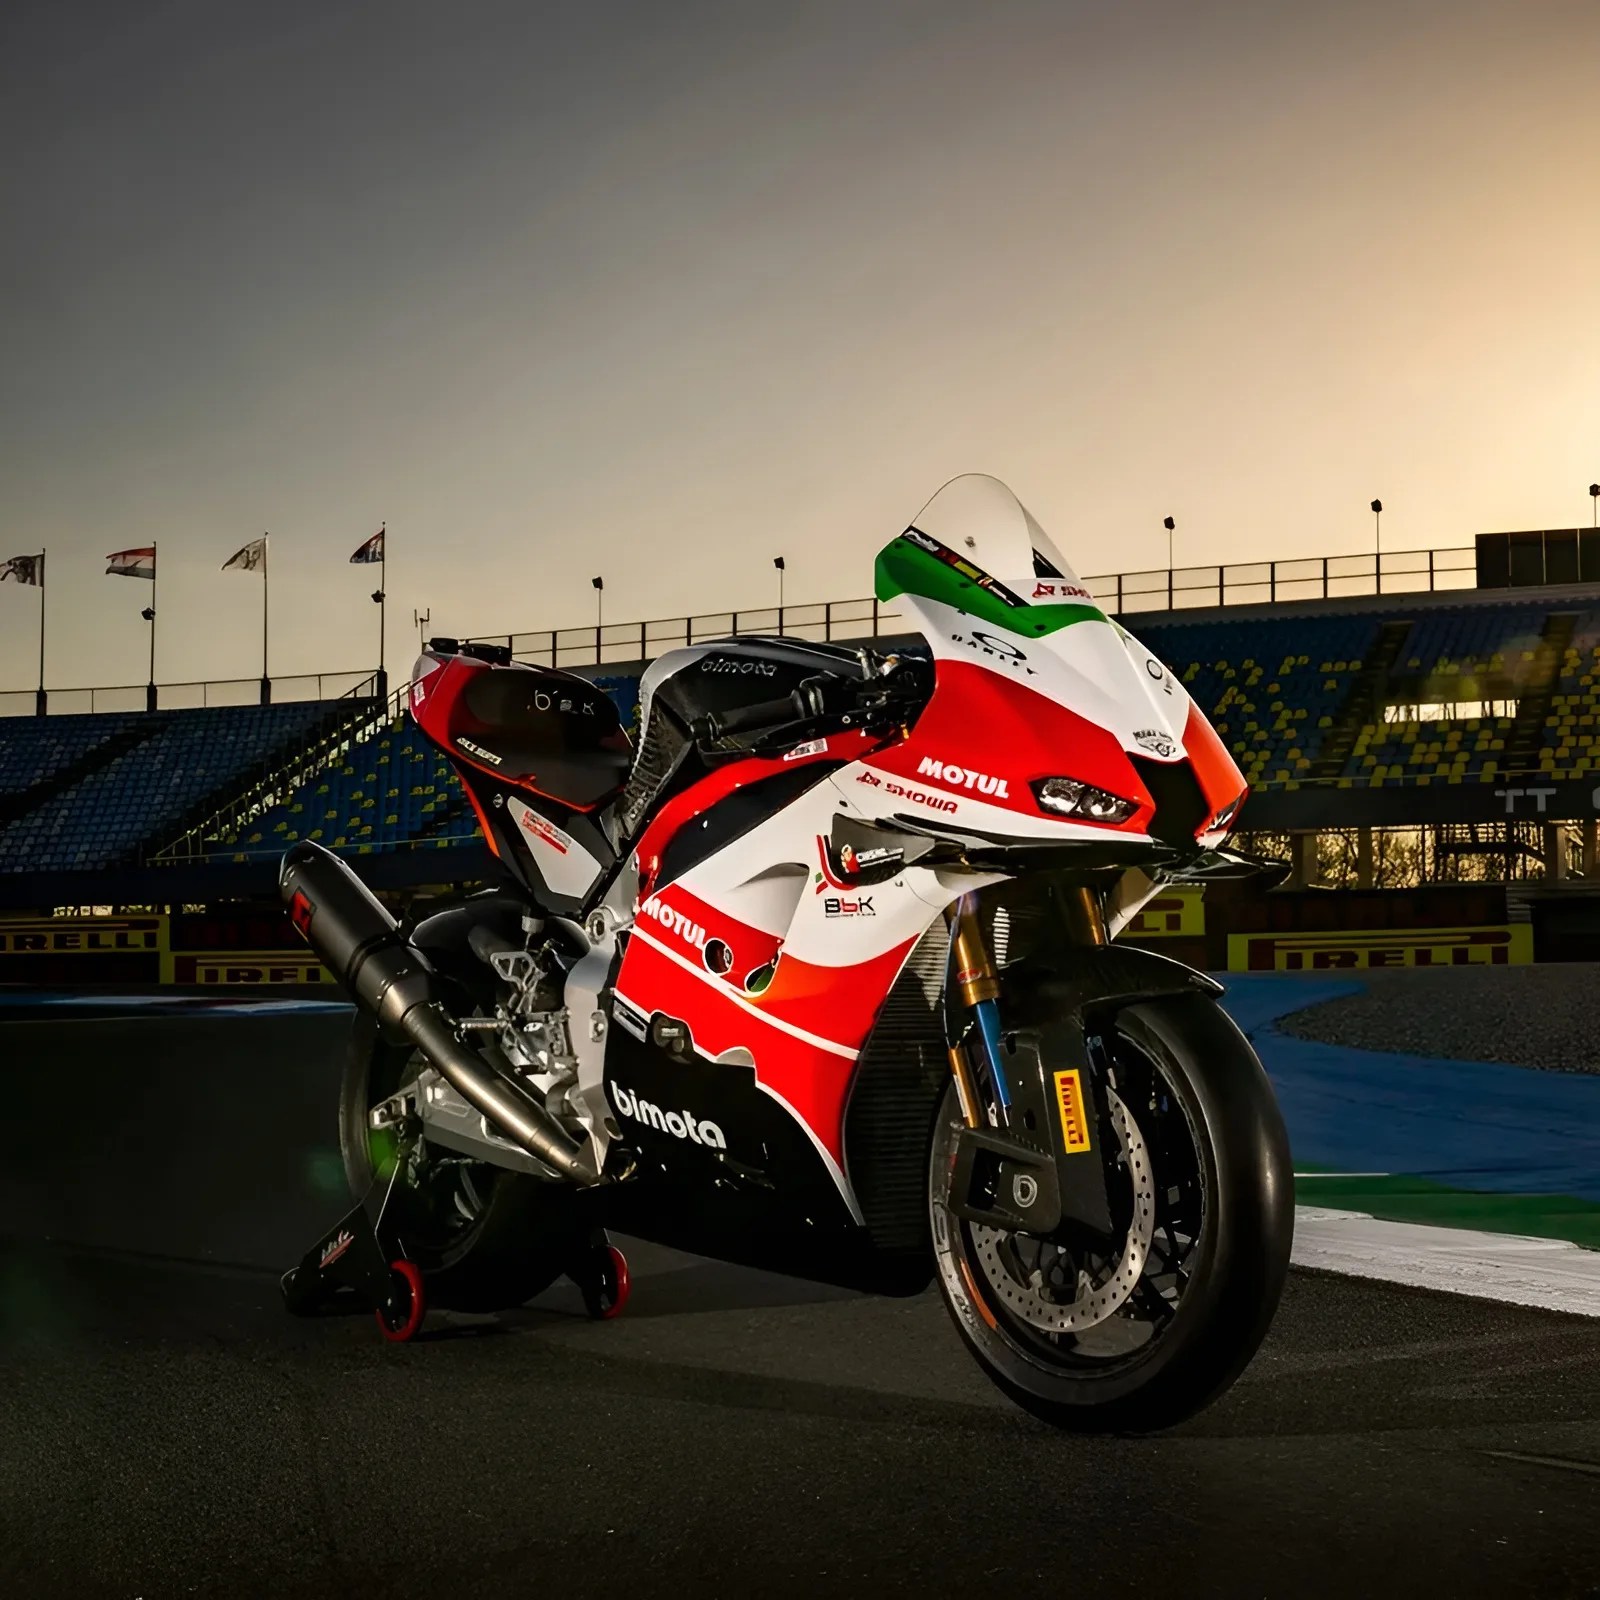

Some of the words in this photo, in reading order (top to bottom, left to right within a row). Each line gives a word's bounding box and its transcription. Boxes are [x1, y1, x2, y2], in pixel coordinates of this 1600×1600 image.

[916, 756, 1010, 799] MOTUL
[885, 783, 959, 815] SHOWA
[1494, 787, 1557, 813] TT
[641, 897, 706, 951] MOTUL
[1247, 931, 1512, 971] PIRELLI
[610, 1079, 727, 1150] bimota
